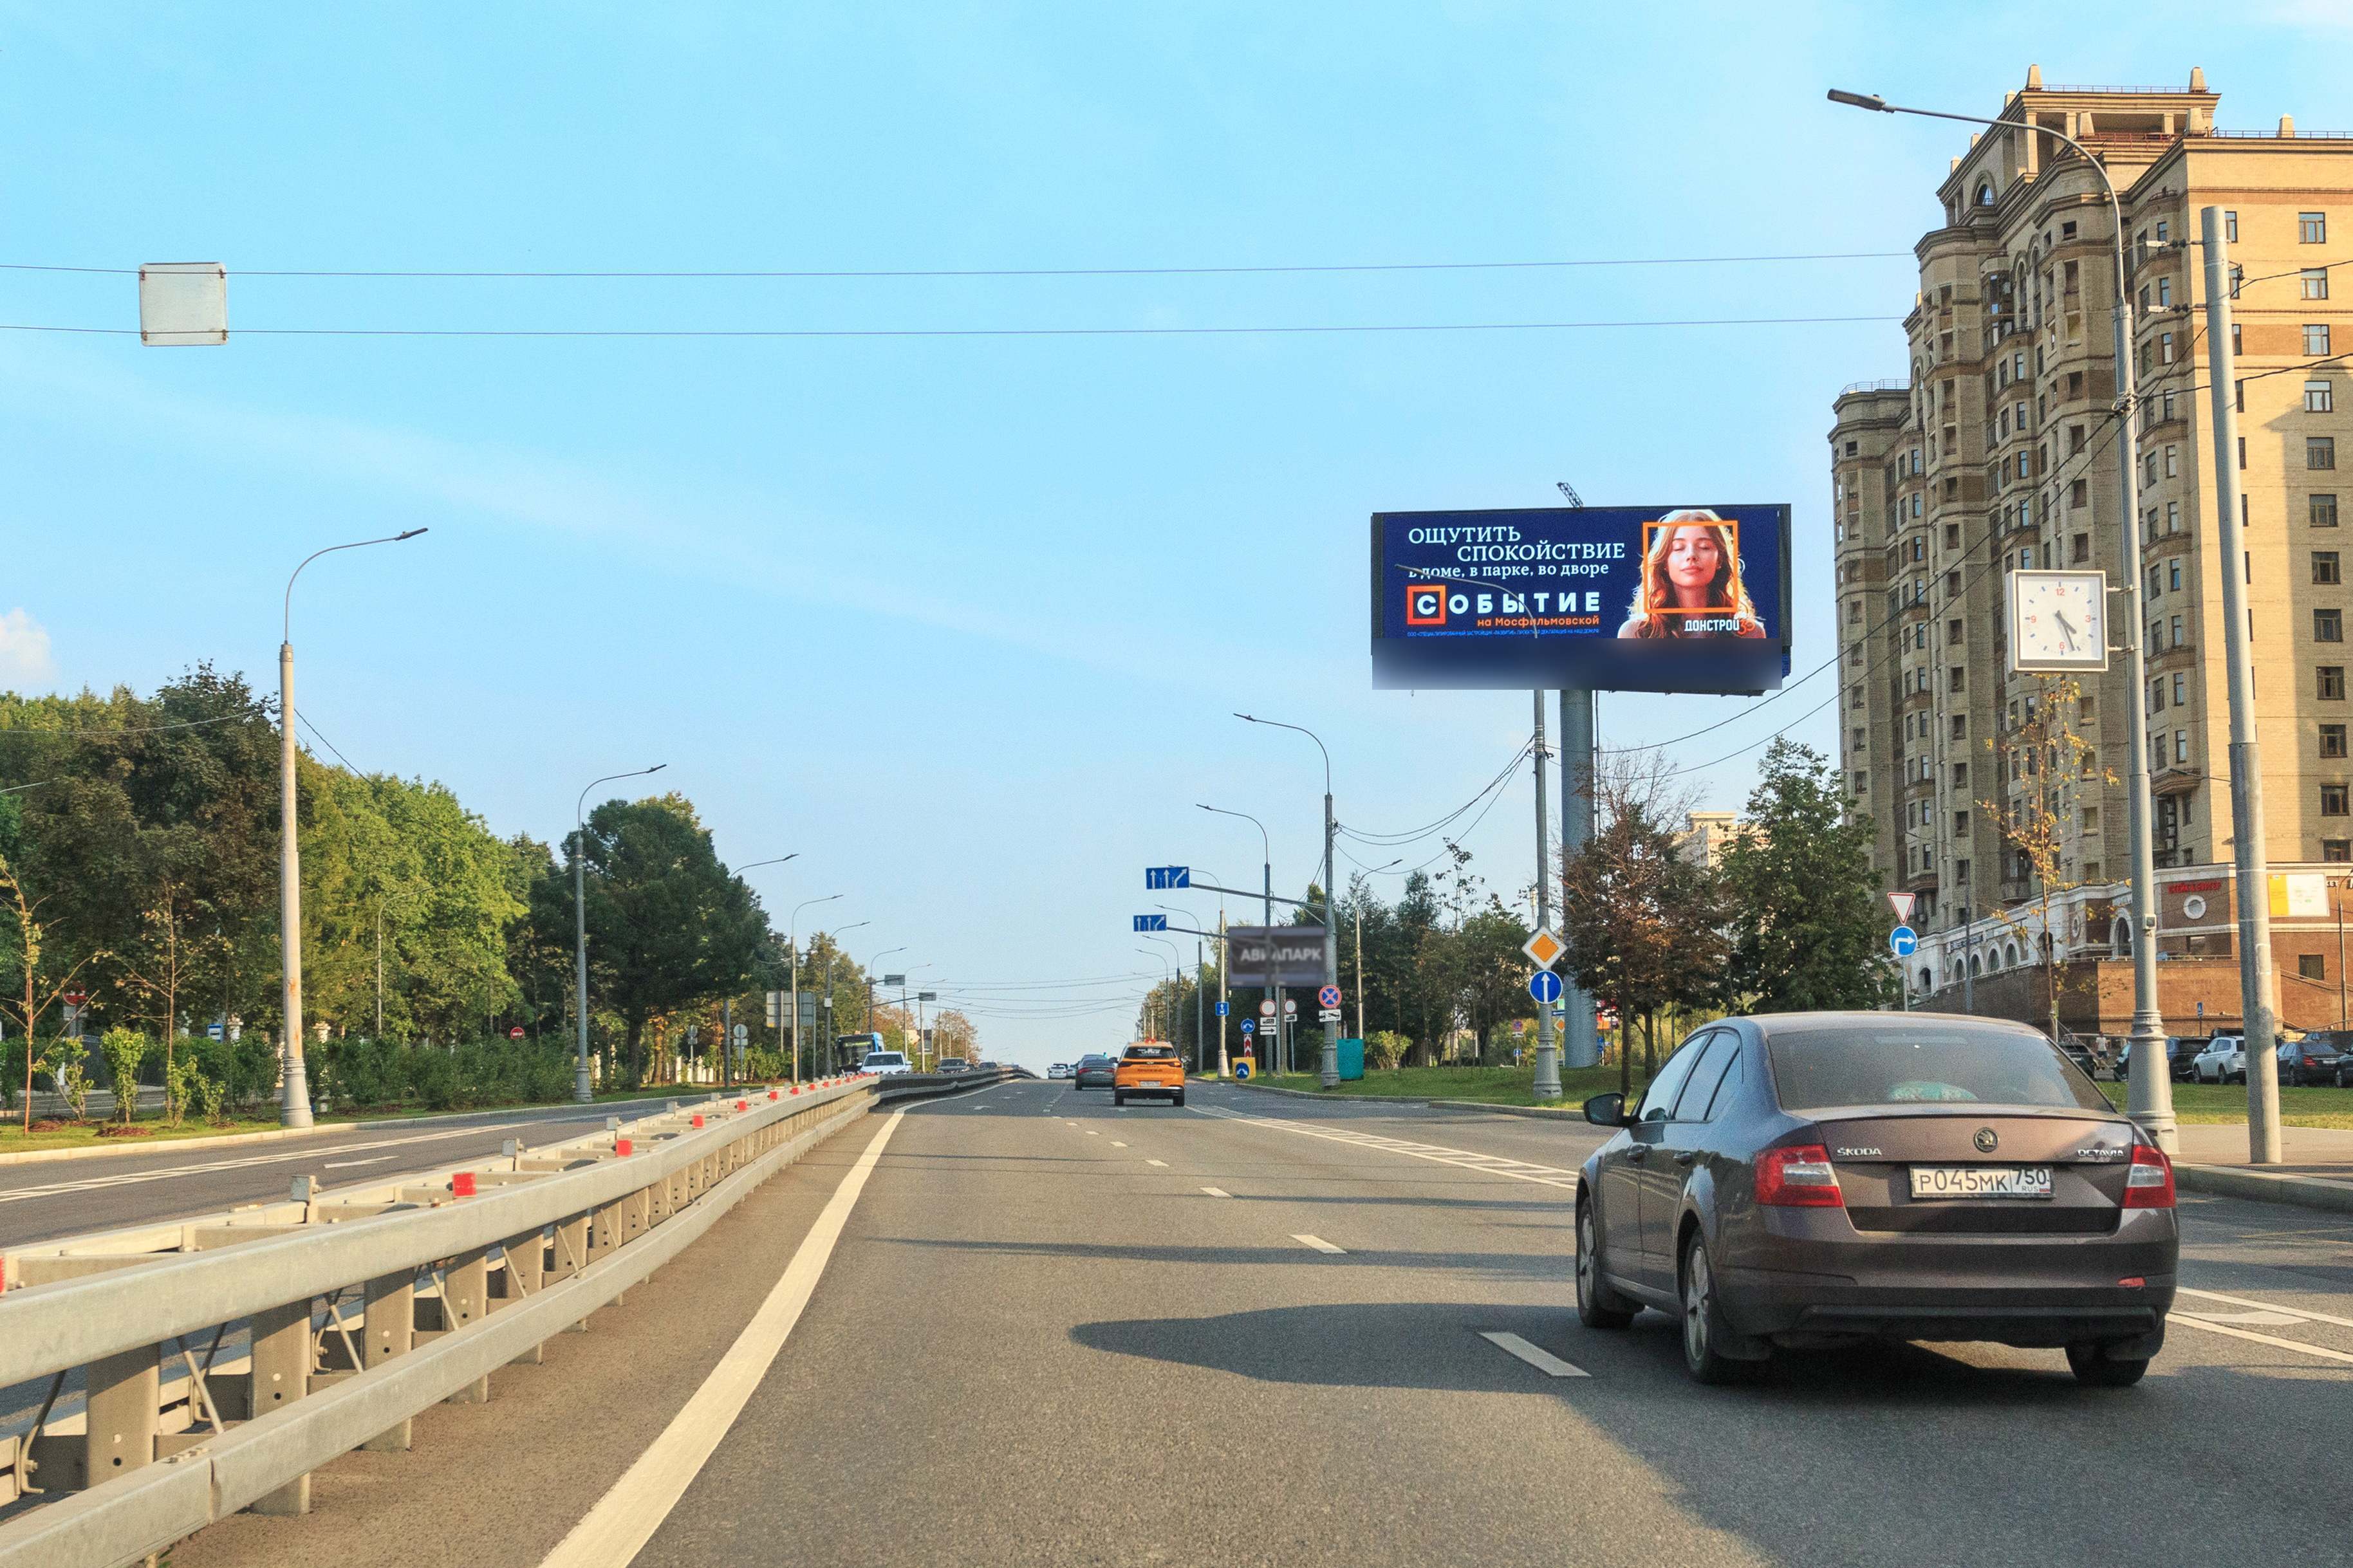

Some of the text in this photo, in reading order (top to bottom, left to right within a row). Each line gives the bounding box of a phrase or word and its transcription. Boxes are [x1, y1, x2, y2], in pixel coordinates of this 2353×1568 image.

[1408, 526, 1521, 546] ОЩУТИТЬ
[1457, 540, 1625, 562] СПОКОЙСТВИЕ
[1470, 567, 1478, 576] в
[1482, 565, 1534, 580] парке,
[1538, 565, 1556, 575] во
[1561, 564, 1609, 578] дворе
[1417, 591, 1600, 615] СОБЫТИЕ
[1495, 615, 1599, 628] Мосфильмовской
[2060, 641, 2065, 650] 6
[1837, 1147, 1883, 1156] ŠKODA
[2013, 1169, 2047, 1185] 750
